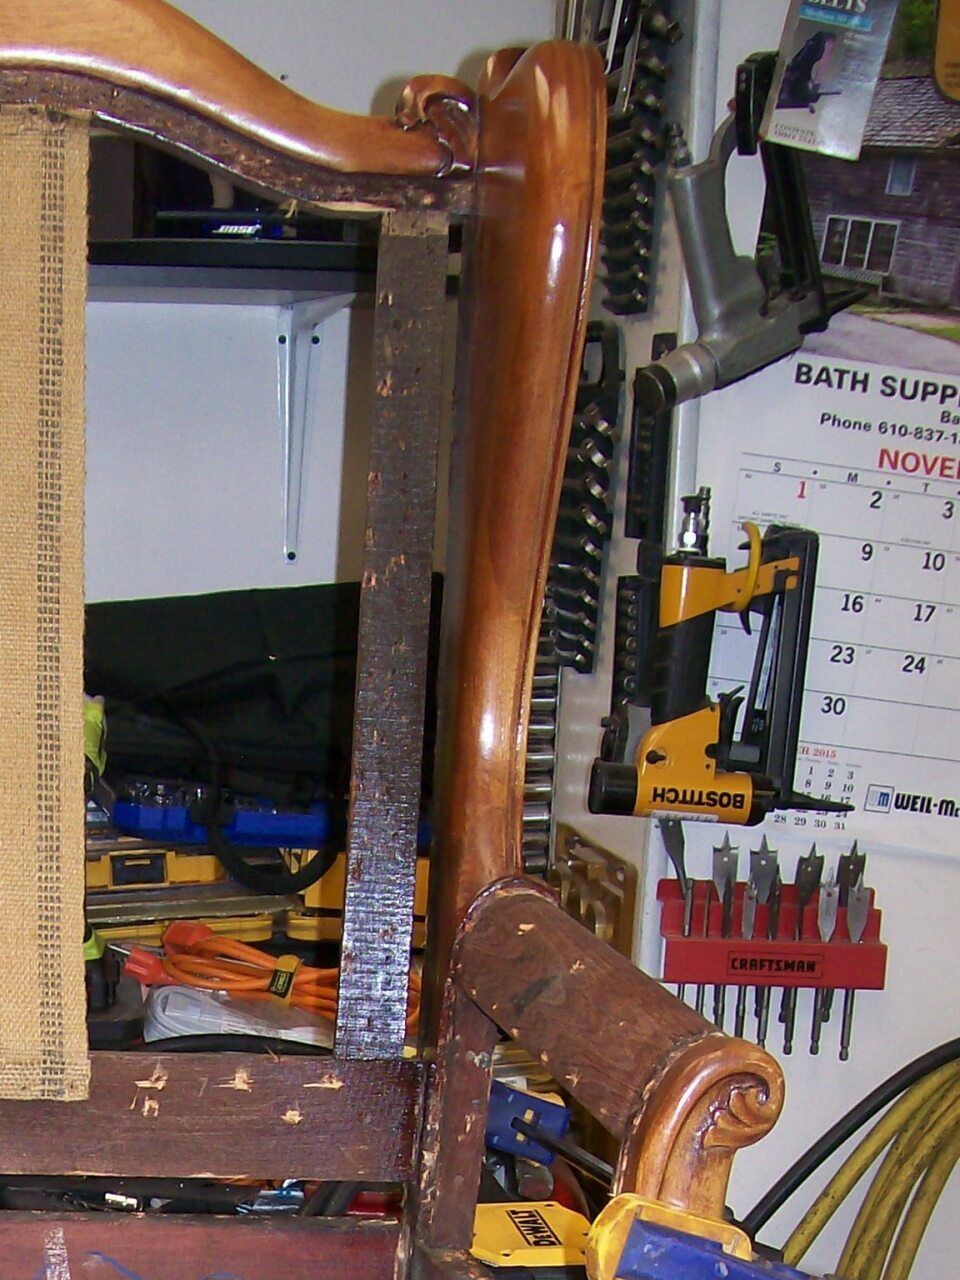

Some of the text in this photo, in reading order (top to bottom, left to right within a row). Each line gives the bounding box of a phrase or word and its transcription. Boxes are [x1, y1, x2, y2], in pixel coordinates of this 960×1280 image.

[795, 362, 960, 408] BATH SUPP
[820, 412, 960, 445] Phone 610-837-1
[774, 462, 931, 493] S M T
[878, 448, 960, 480] NOVE
[797, 481, 955, 519] 1 2 3
[860, 543, 945, 571] 9 10
[841, 593, 936, 623] 16 17
[830, 645, 926, 674] 23 24
[821, 696, 846, 715] 30
[813, 749, 837, 759] 2015
[827, 768, 835, 778] 2
[652, 786, 745, 809] BOSTITCH
[842, 784, 854, 793] 10
[774, 814, 846, 831] 28 29 30 31
[730, 957, 816, 973] CRAFTSMAN
